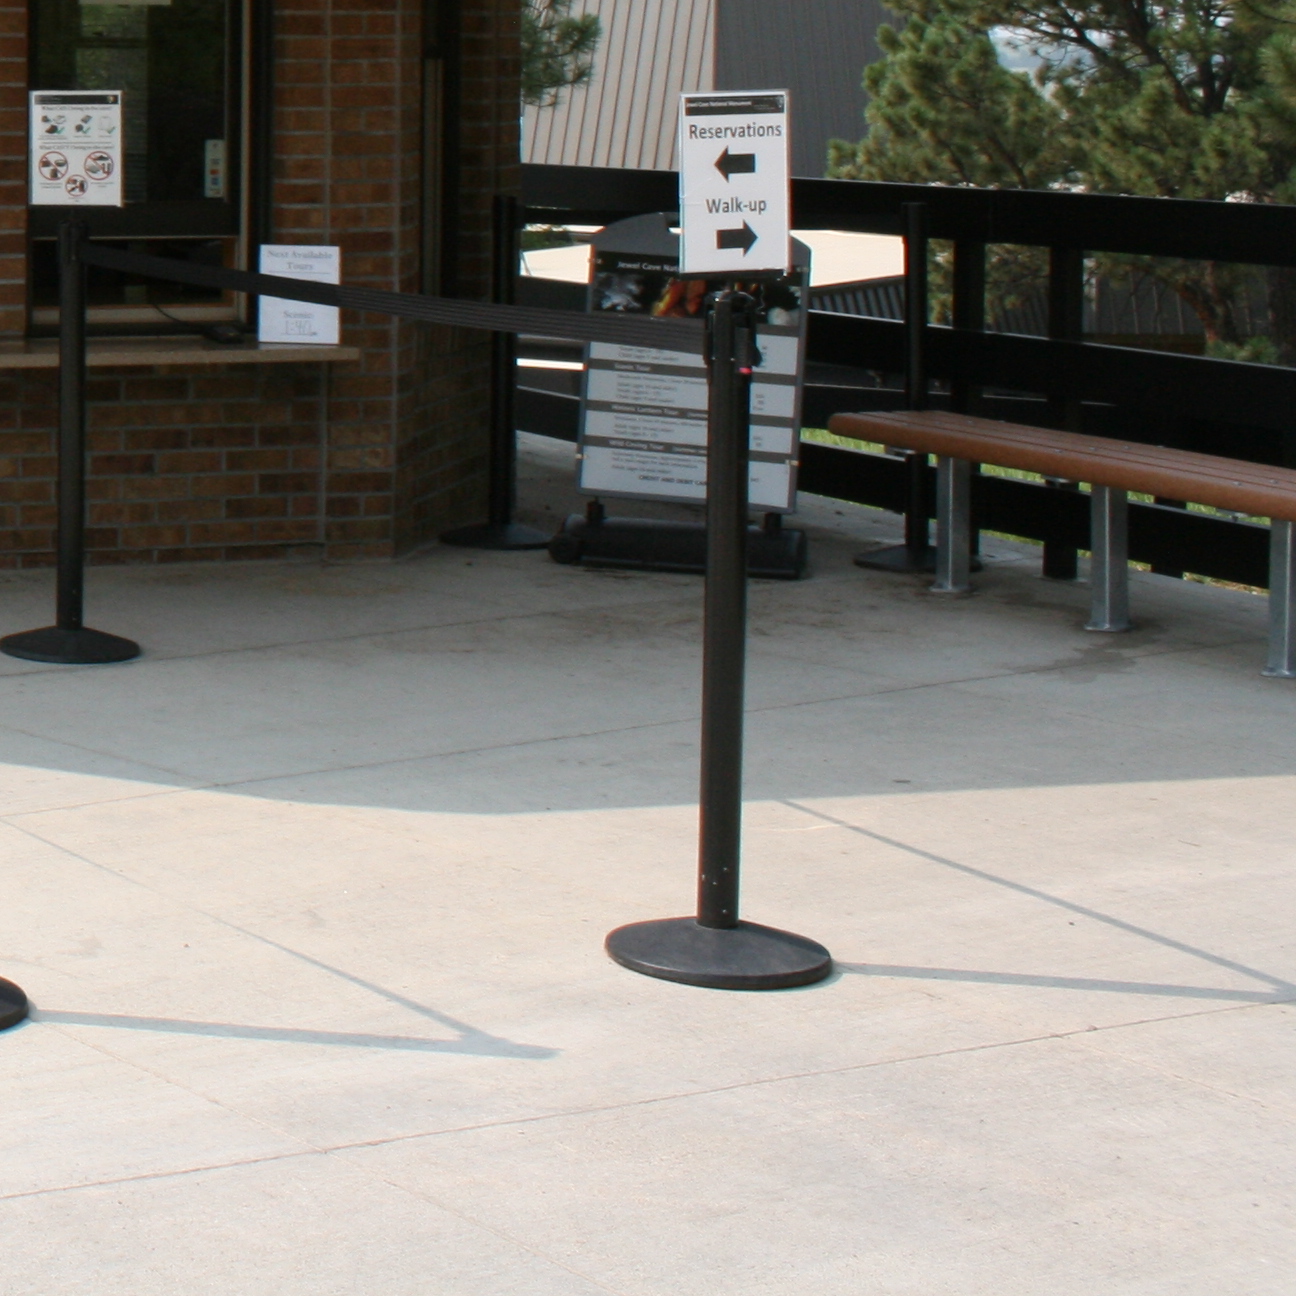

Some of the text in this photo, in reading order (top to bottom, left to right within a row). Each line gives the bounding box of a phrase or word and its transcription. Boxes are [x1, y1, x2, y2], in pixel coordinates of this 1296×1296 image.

[689, 122, 782, 139] Reservations
[706, 197, 767, 215] Walk-up
[267, 250, 333, 259] Next Available
[618, 261, 639, 270] Jewel
[643, 263, 661, 271] Cave
